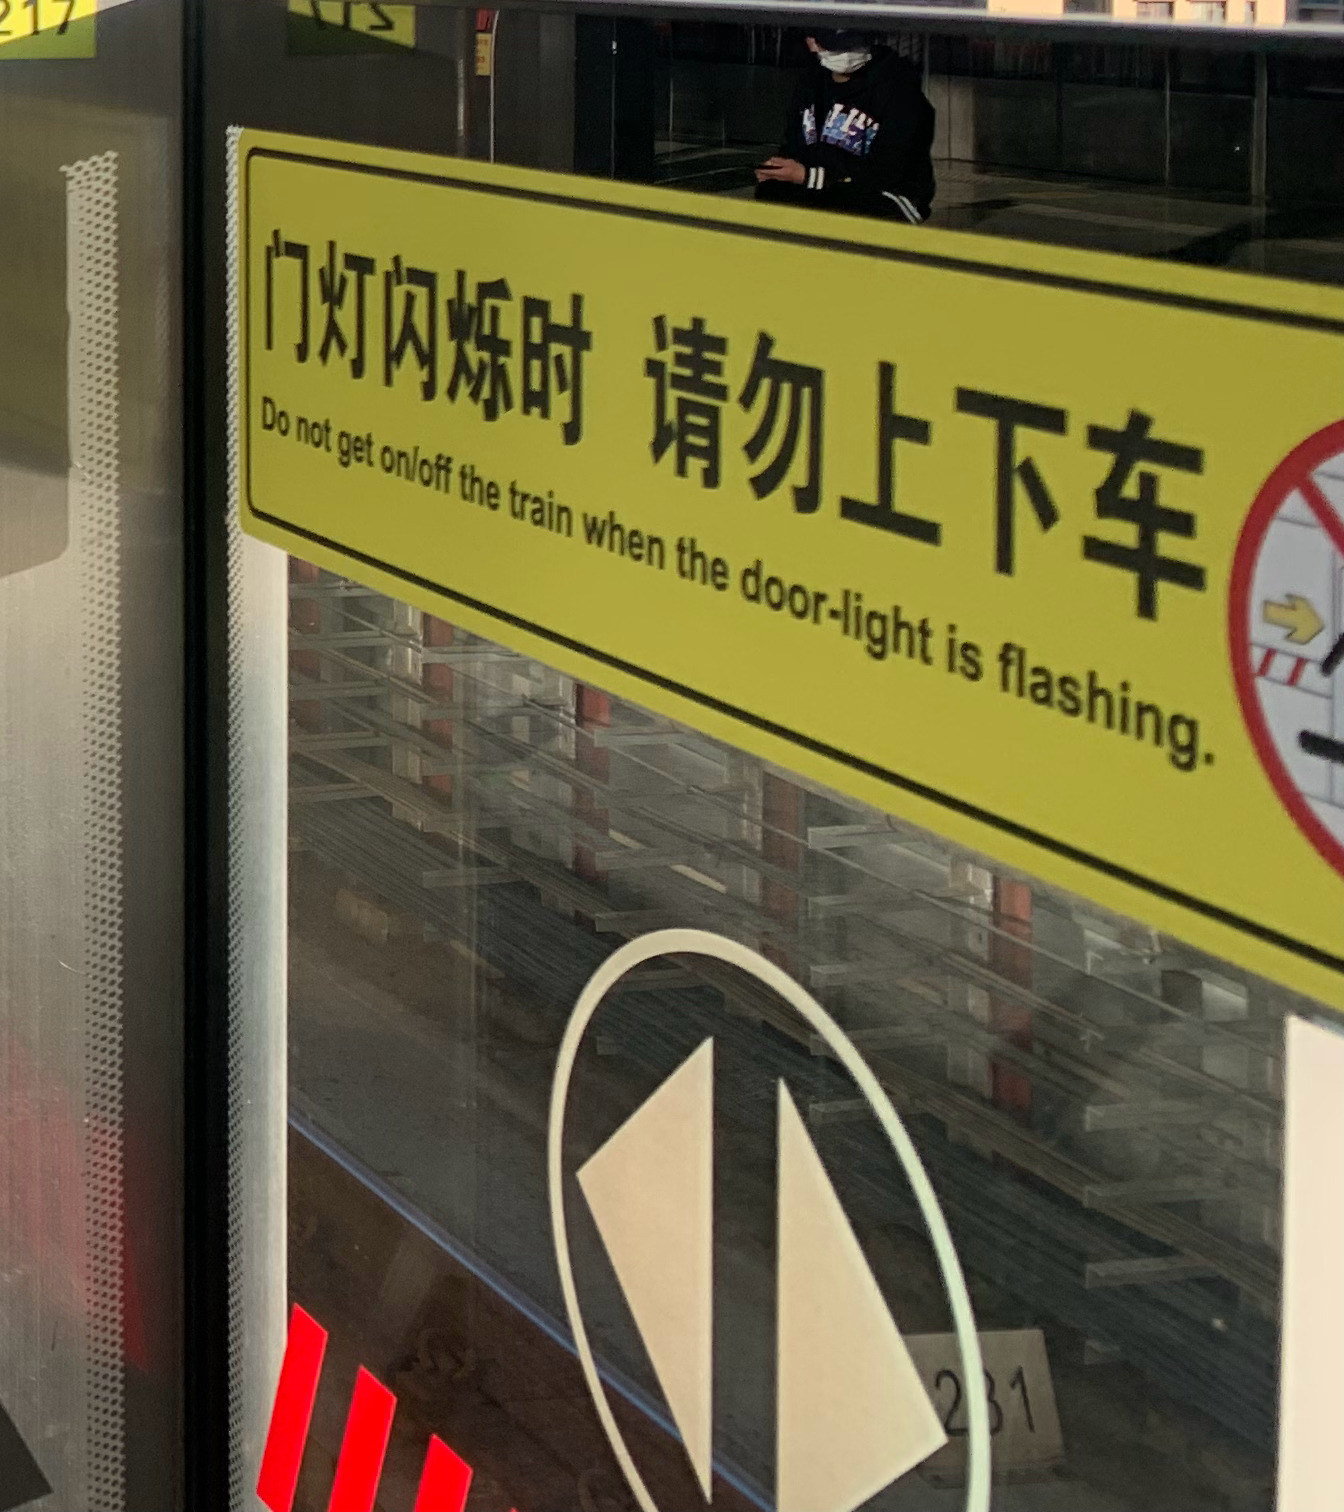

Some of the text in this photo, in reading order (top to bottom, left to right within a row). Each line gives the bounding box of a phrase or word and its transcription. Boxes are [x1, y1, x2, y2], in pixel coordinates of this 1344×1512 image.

[262, 395, 1216, 773] Do not get on/off the train when the door-light is flashing.
[265, 228, 1208, 622] 门灯闪烁时 请勿上下车
